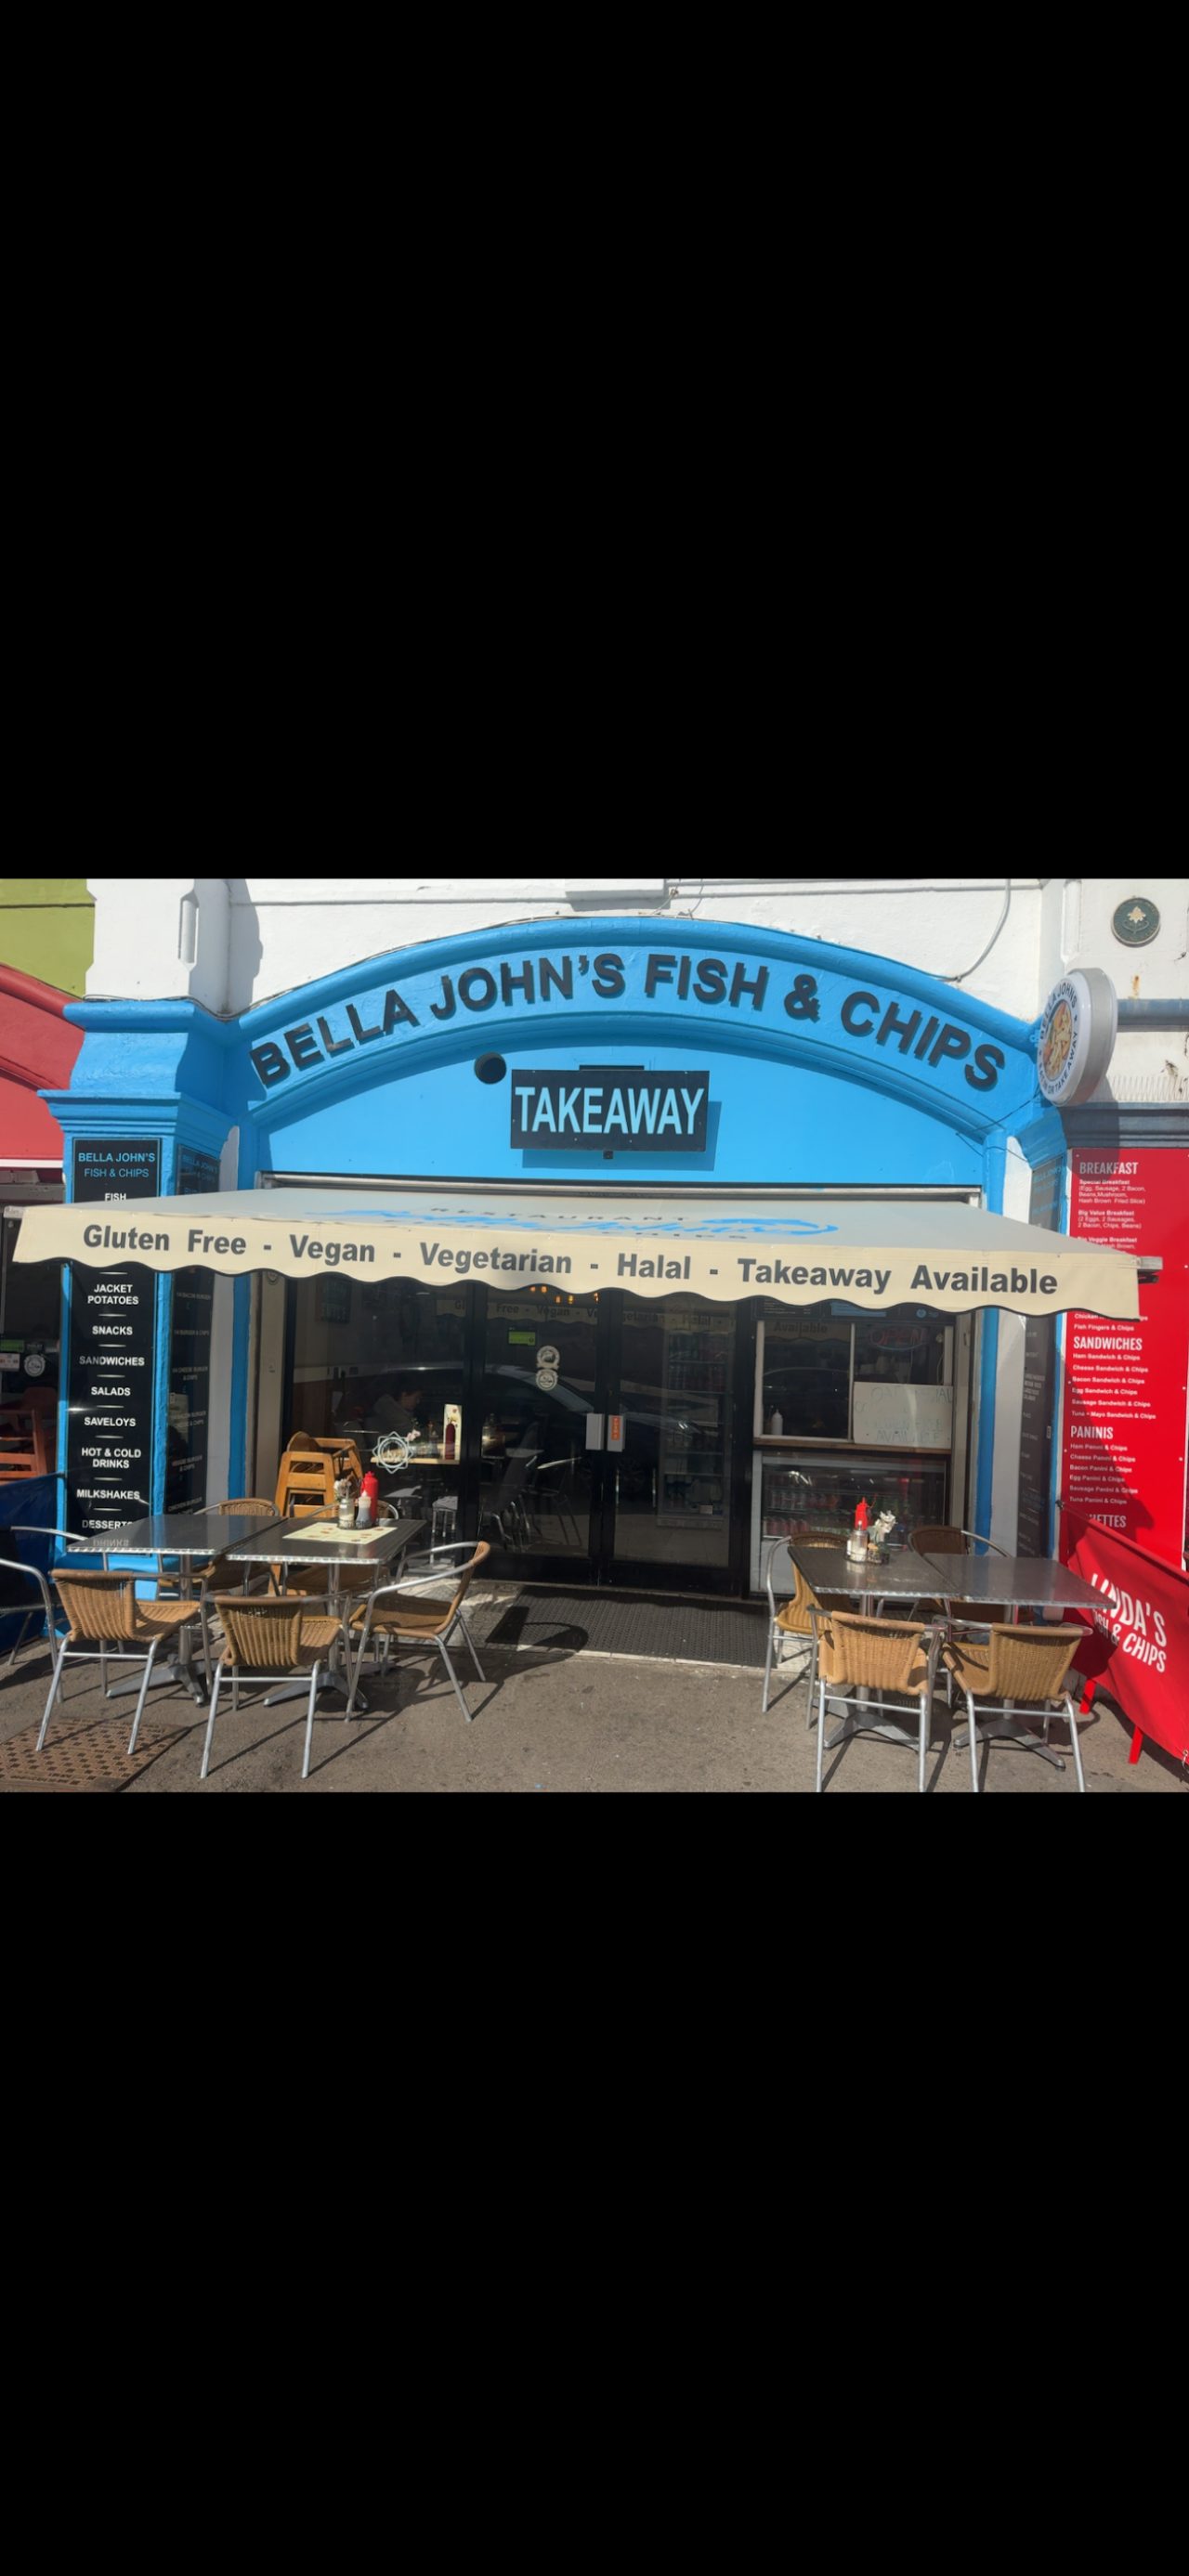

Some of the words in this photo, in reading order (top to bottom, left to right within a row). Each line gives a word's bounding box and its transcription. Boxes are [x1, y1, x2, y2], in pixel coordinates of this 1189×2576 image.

[1057, 982, 1078, 1008] JOHNS
[248, 989, 420, 1086] BELLA
[644, 954, 768, 1008] FISH
[783, 973, 819, 1021] &
[841, 991, 1006, 1090] CHIPS
[515, 1087, 704, 1135] TAKEAWAY
[78, 1152, 113, 1162] BELLA
[115, 1152, 156, 1163] JOHN'S
[84, 1168, 108, 1177] FISH
[109, 1168, 116, 1177] &
[119, 1168, 150, 1177] CHIPS
[1079, 1162, 1138, 1175] BREAKFAST
[104, 1192, 126, 1202] FISH
[83, 1224, 170, 1251] Gluten
[188, 1229, 246, 1255] Free
[290, 1234, 375, 1266] Vegan
[420, 1242, 571, 1274] Vegetarian
[617, 1253, 690, 1280] Halal
[738, 1258, 892, 1295] Takeaway
[910, 1265, 1058, 1295] Available
[94, 1284, 133, 1293] JACKET
[87, 1295, 139, 1305] POTATOES
[92, 1326, 133, 1335] SNACKS
[773, 1321, 828, 1334] Available
[869, 1328, 924, 1346] OPEN
[1074, 1336, 1143, 1350] SANDWICHES
[79, 1356, 145, 1366] SANDWICHES
[91, 1386, 131, 1396] SALADS
[84, 1417, 136, 1426] SAVELOYS
[1070, 1425, 1113, 1439] PANINIS
[82, 1447, 102, 1457] HOT
[104, 1448, 111, 1457] &
[113, 1449, 141, 1458] COLD
[93, 1459, 129, 1468] DRINKS
[76, 1489, 140, 1500] MILKSHAKES
[82, 1519, 133, 1529] DESSERT
[1089, 1513, 1127, 1529] ETTES
[1110, 1623, 1122, 1647] &
[1122, 1633, 1167, 1672] CHIPS
